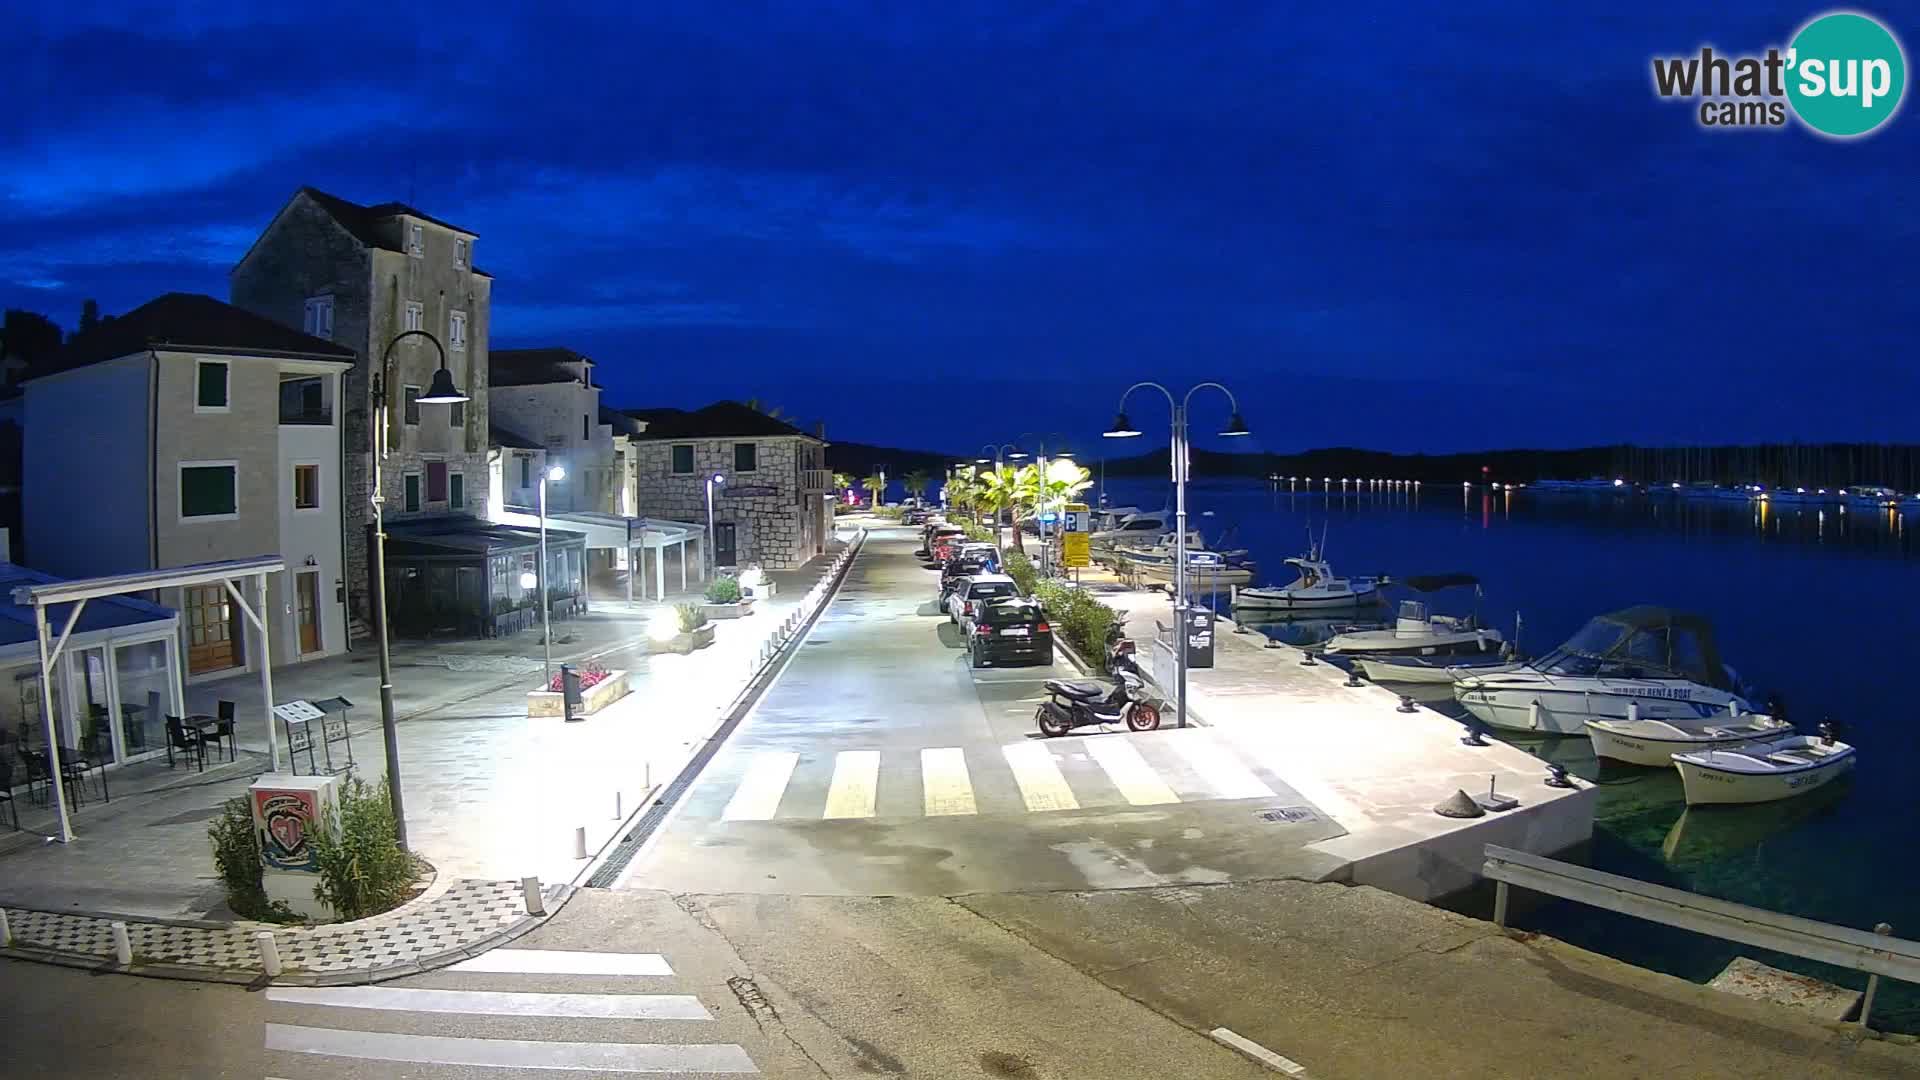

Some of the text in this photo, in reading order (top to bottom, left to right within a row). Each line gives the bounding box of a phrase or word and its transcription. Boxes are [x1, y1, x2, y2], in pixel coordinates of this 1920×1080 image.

[1066, 514, 1076, 530] P
[1647, 688, 1665, 697] RENT
[1674, 688, 1692, 700] BOAT
